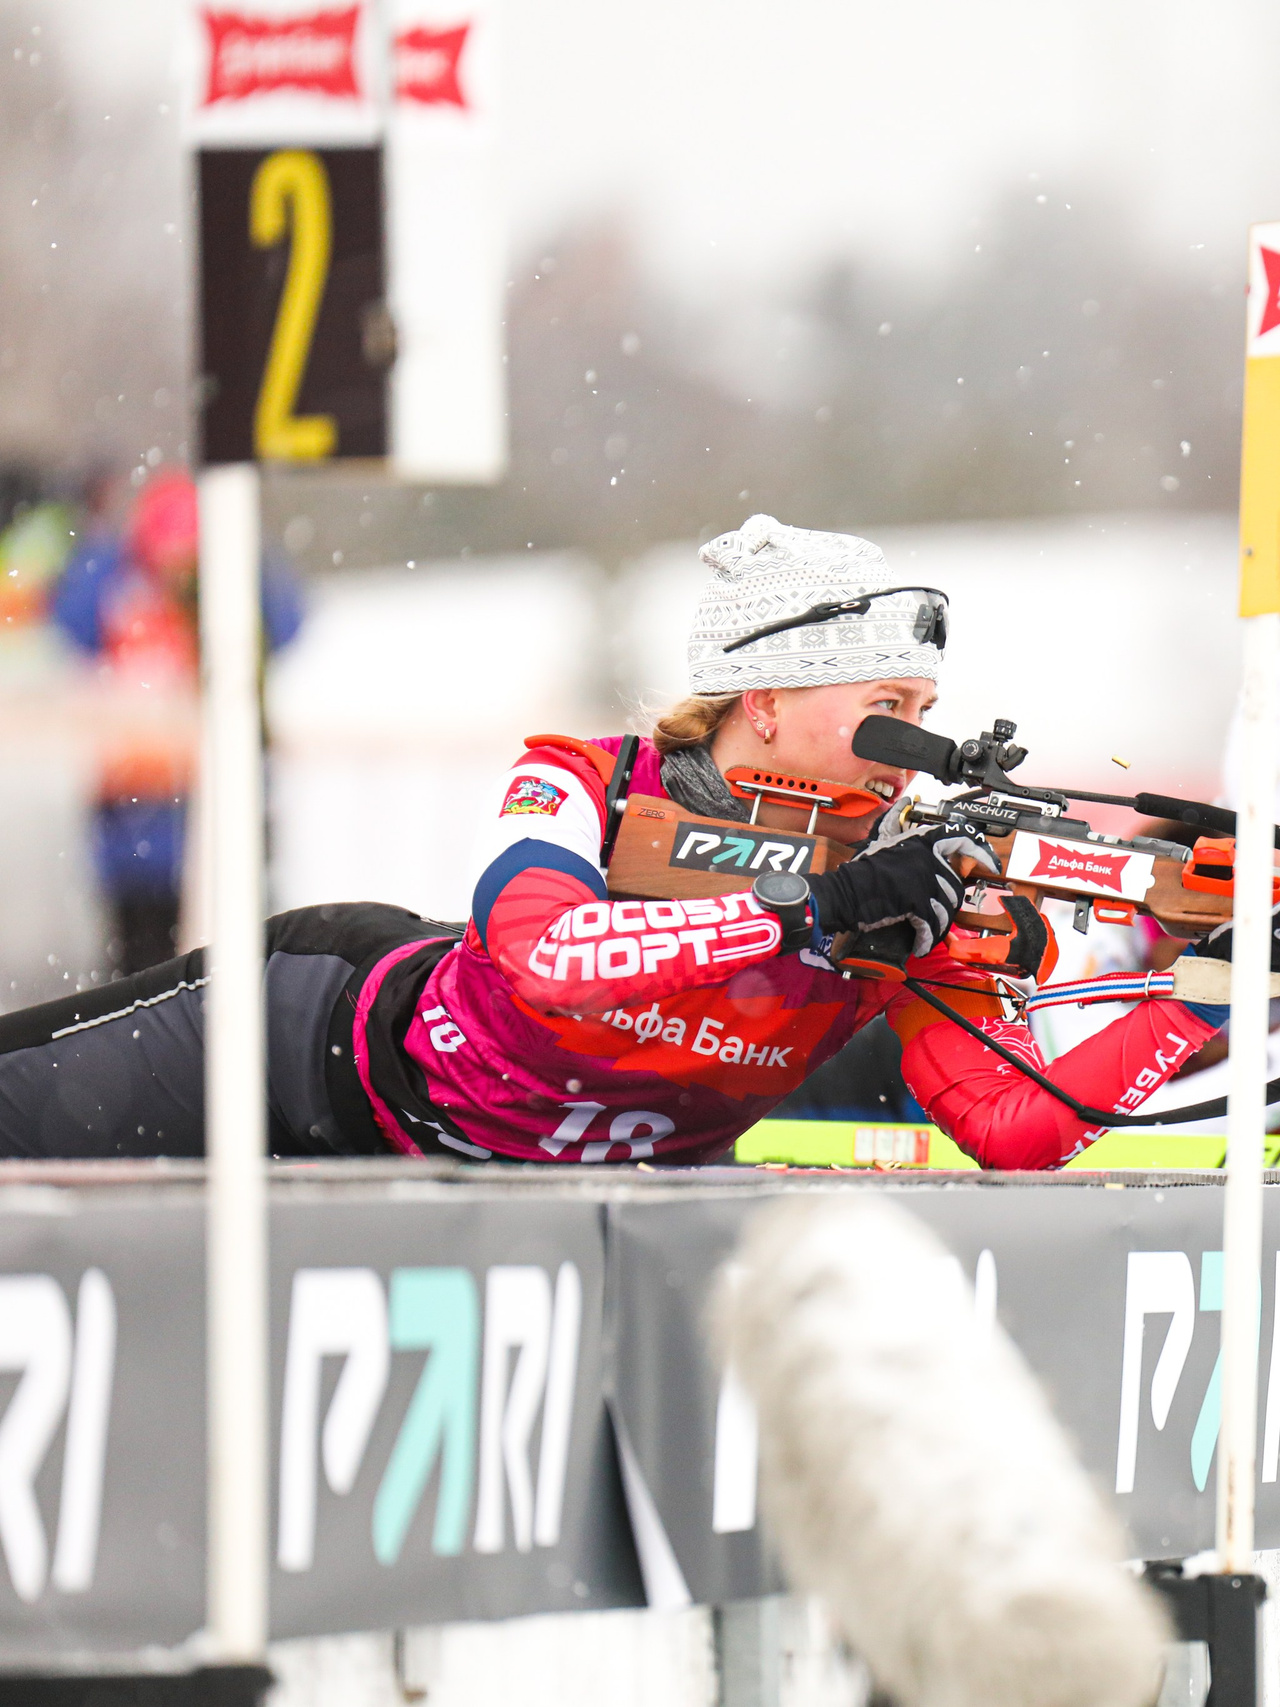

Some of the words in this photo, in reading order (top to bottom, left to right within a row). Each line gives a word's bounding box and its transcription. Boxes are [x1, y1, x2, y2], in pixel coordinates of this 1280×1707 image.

[249, 150, 336, 459] 2
[638, 808, 665, 819] ZERO
[953, 801, 1017, 820] ANSCHUTZ
[676, 831, 809, 874] PARI
[945, 823, 994, 851] MOA
[1048, 855, 1085, 870] Альфа
[1085, 858, 1112, 875] Банк
[528, 926, 718, 981] СПОРТ
[573, 1002, 687, 1047] ьфа
[691, 1016, 794, 1068] Банк
[538, 1101, 676, 1164] 18
[278, 1261, 582, 1572] PARI
